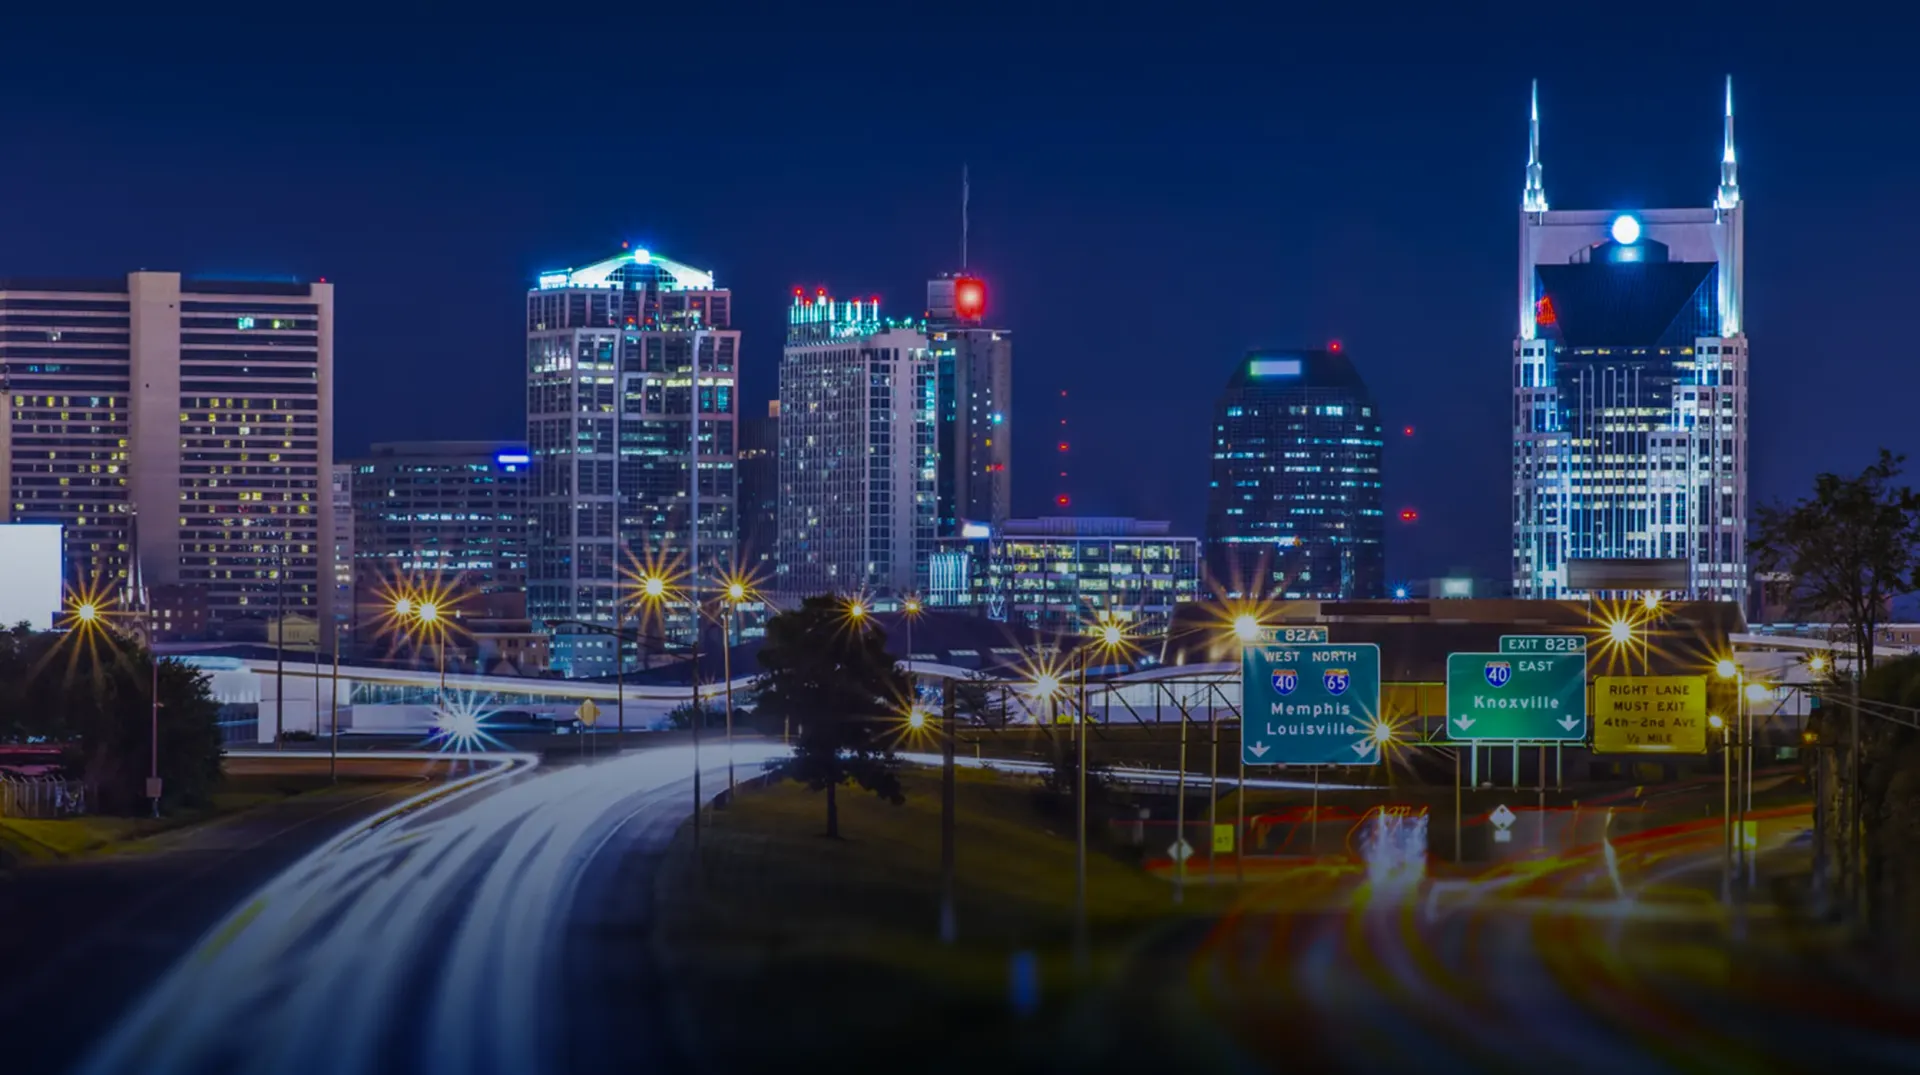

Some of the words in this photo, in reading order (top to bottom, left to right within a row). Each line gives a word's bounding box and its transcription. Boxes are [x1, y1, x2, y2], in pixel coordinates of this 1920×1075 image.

[1285, 629, 1319, 642] 82A
[1508, 639, 1538, 650] EXIT
[1545, 638, 1578, 651] 82B
[1264, 651, 1300, 662] WEST
[1312, 651, 1357, 662] NORTH
[1518, 661, 1554, 672] EAST
[1488, 667, 1508, 682] 40
[1275, 675, 1295, 690] 40
[1327, 675, 1346, 690] 65
[1609, 685, 1648, 695] RIGHT
[1656, 685, 1690, 695] LANE
[1474, 696, 1559, 709] Knoxville
[1614, 701, 1649, 712] MUST
[1657, 701, 1686, 712] EXIT
[1271, 702, 1350, 718] Memphis
[1267, 722, 1355, 735] Louisville
[1603, 717, 1665, 728] 4th-2nd
[1648, 734, 1673, 743] MILE
